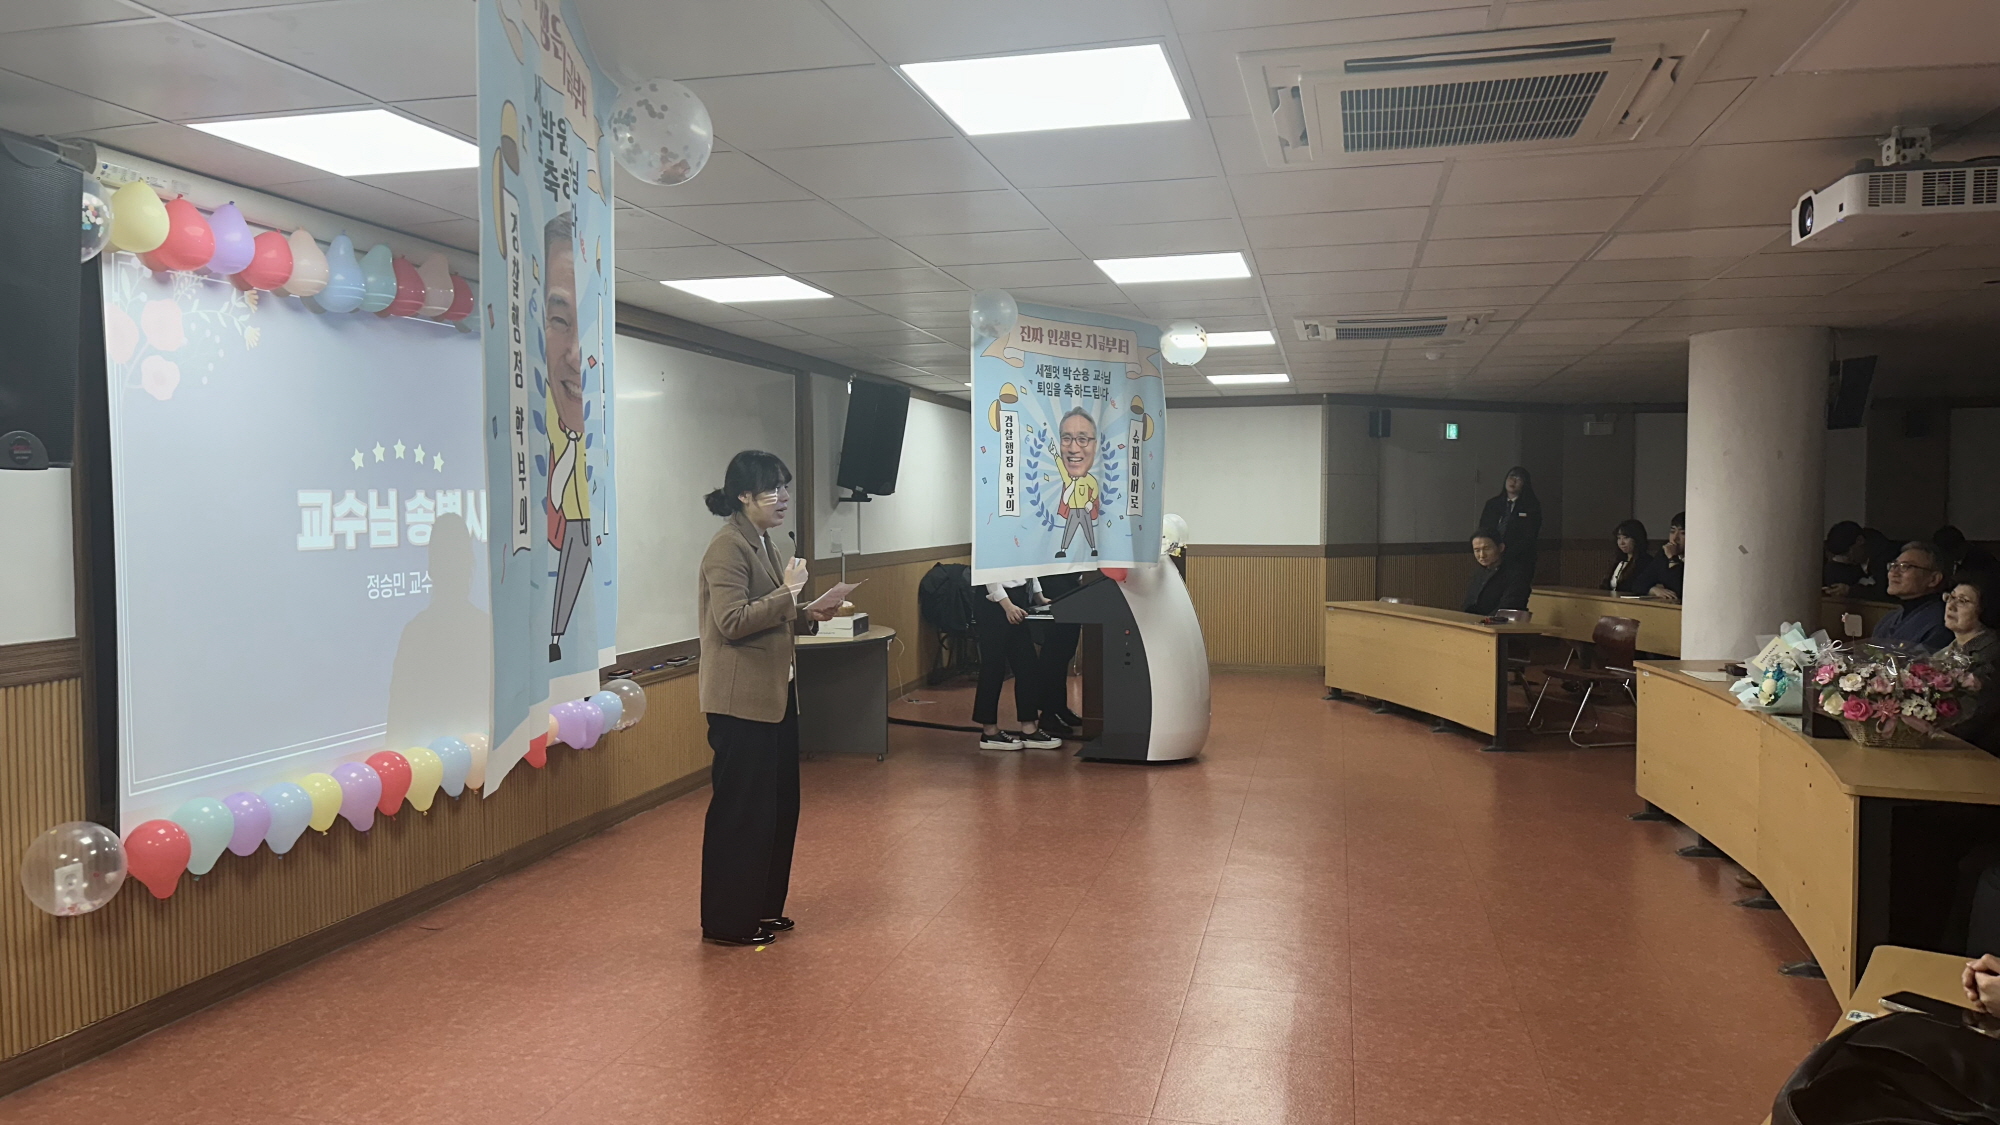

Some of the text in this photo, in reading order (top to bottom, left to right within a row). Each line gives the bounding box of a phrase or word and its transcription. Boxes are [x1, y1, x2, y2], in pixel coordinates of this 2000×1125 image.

[1020, 325, 1130, 355] 진짜 인생은 지금부터
[1035, 363, 1060, 380] 세젤멋
[1062, 366, 1090, 382] 박순용
[1036, 381, 1110, 402] 퇴임을 축하드립다
[1004, 415, 1015, 512] 경찰행정 학부의
[1130, 429, 1140, 509] 슈퍼히어로
[297, 488, 399, 551] 교수님
[366, 570, 434, 599] 정승민 교수
